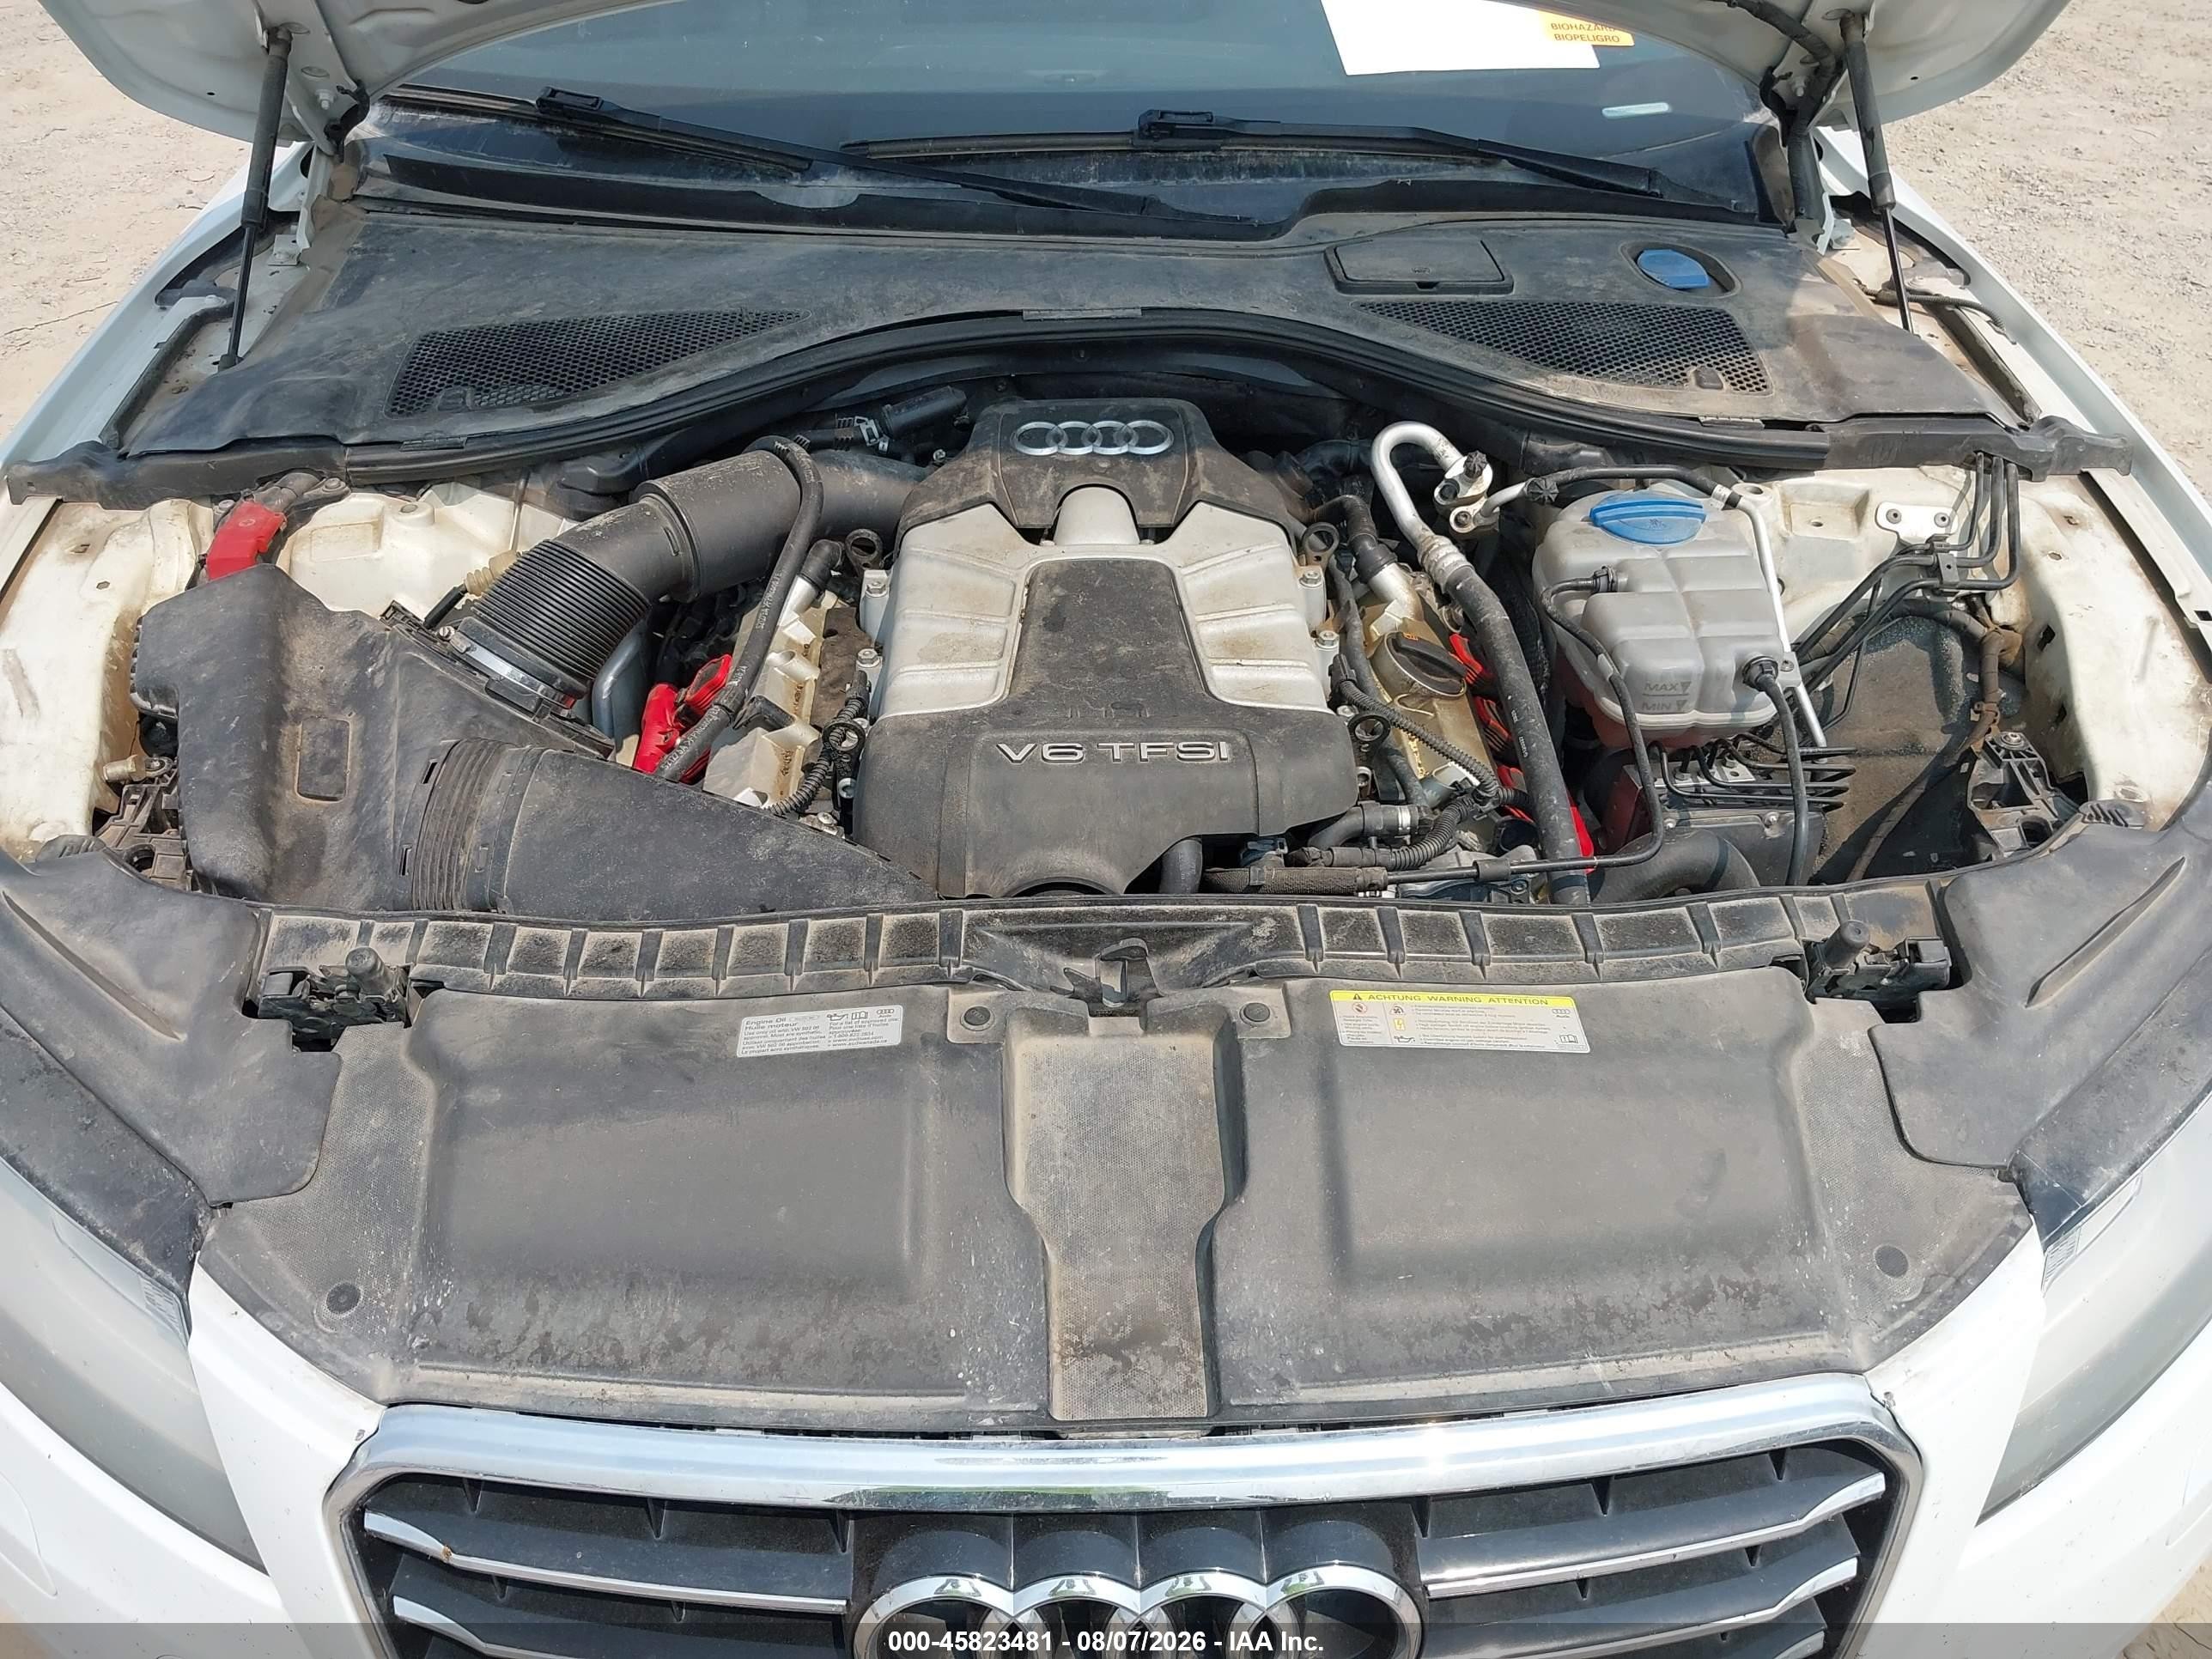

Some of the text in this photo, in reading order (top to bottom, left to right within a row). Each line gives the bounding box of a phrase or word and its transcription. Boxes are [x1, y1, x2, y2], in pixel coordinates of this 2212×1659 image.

[1553, 33, 1620, 42] BIOPELIGRO
[1644, 681, 1680, 692] MAX
[1642, 702, 1671, 711] MIN
[996, 741, 1231, 763] V6 TFSI
[1368, 993, 1549, 1006] ACHTUNG WARNING ATTENTION
